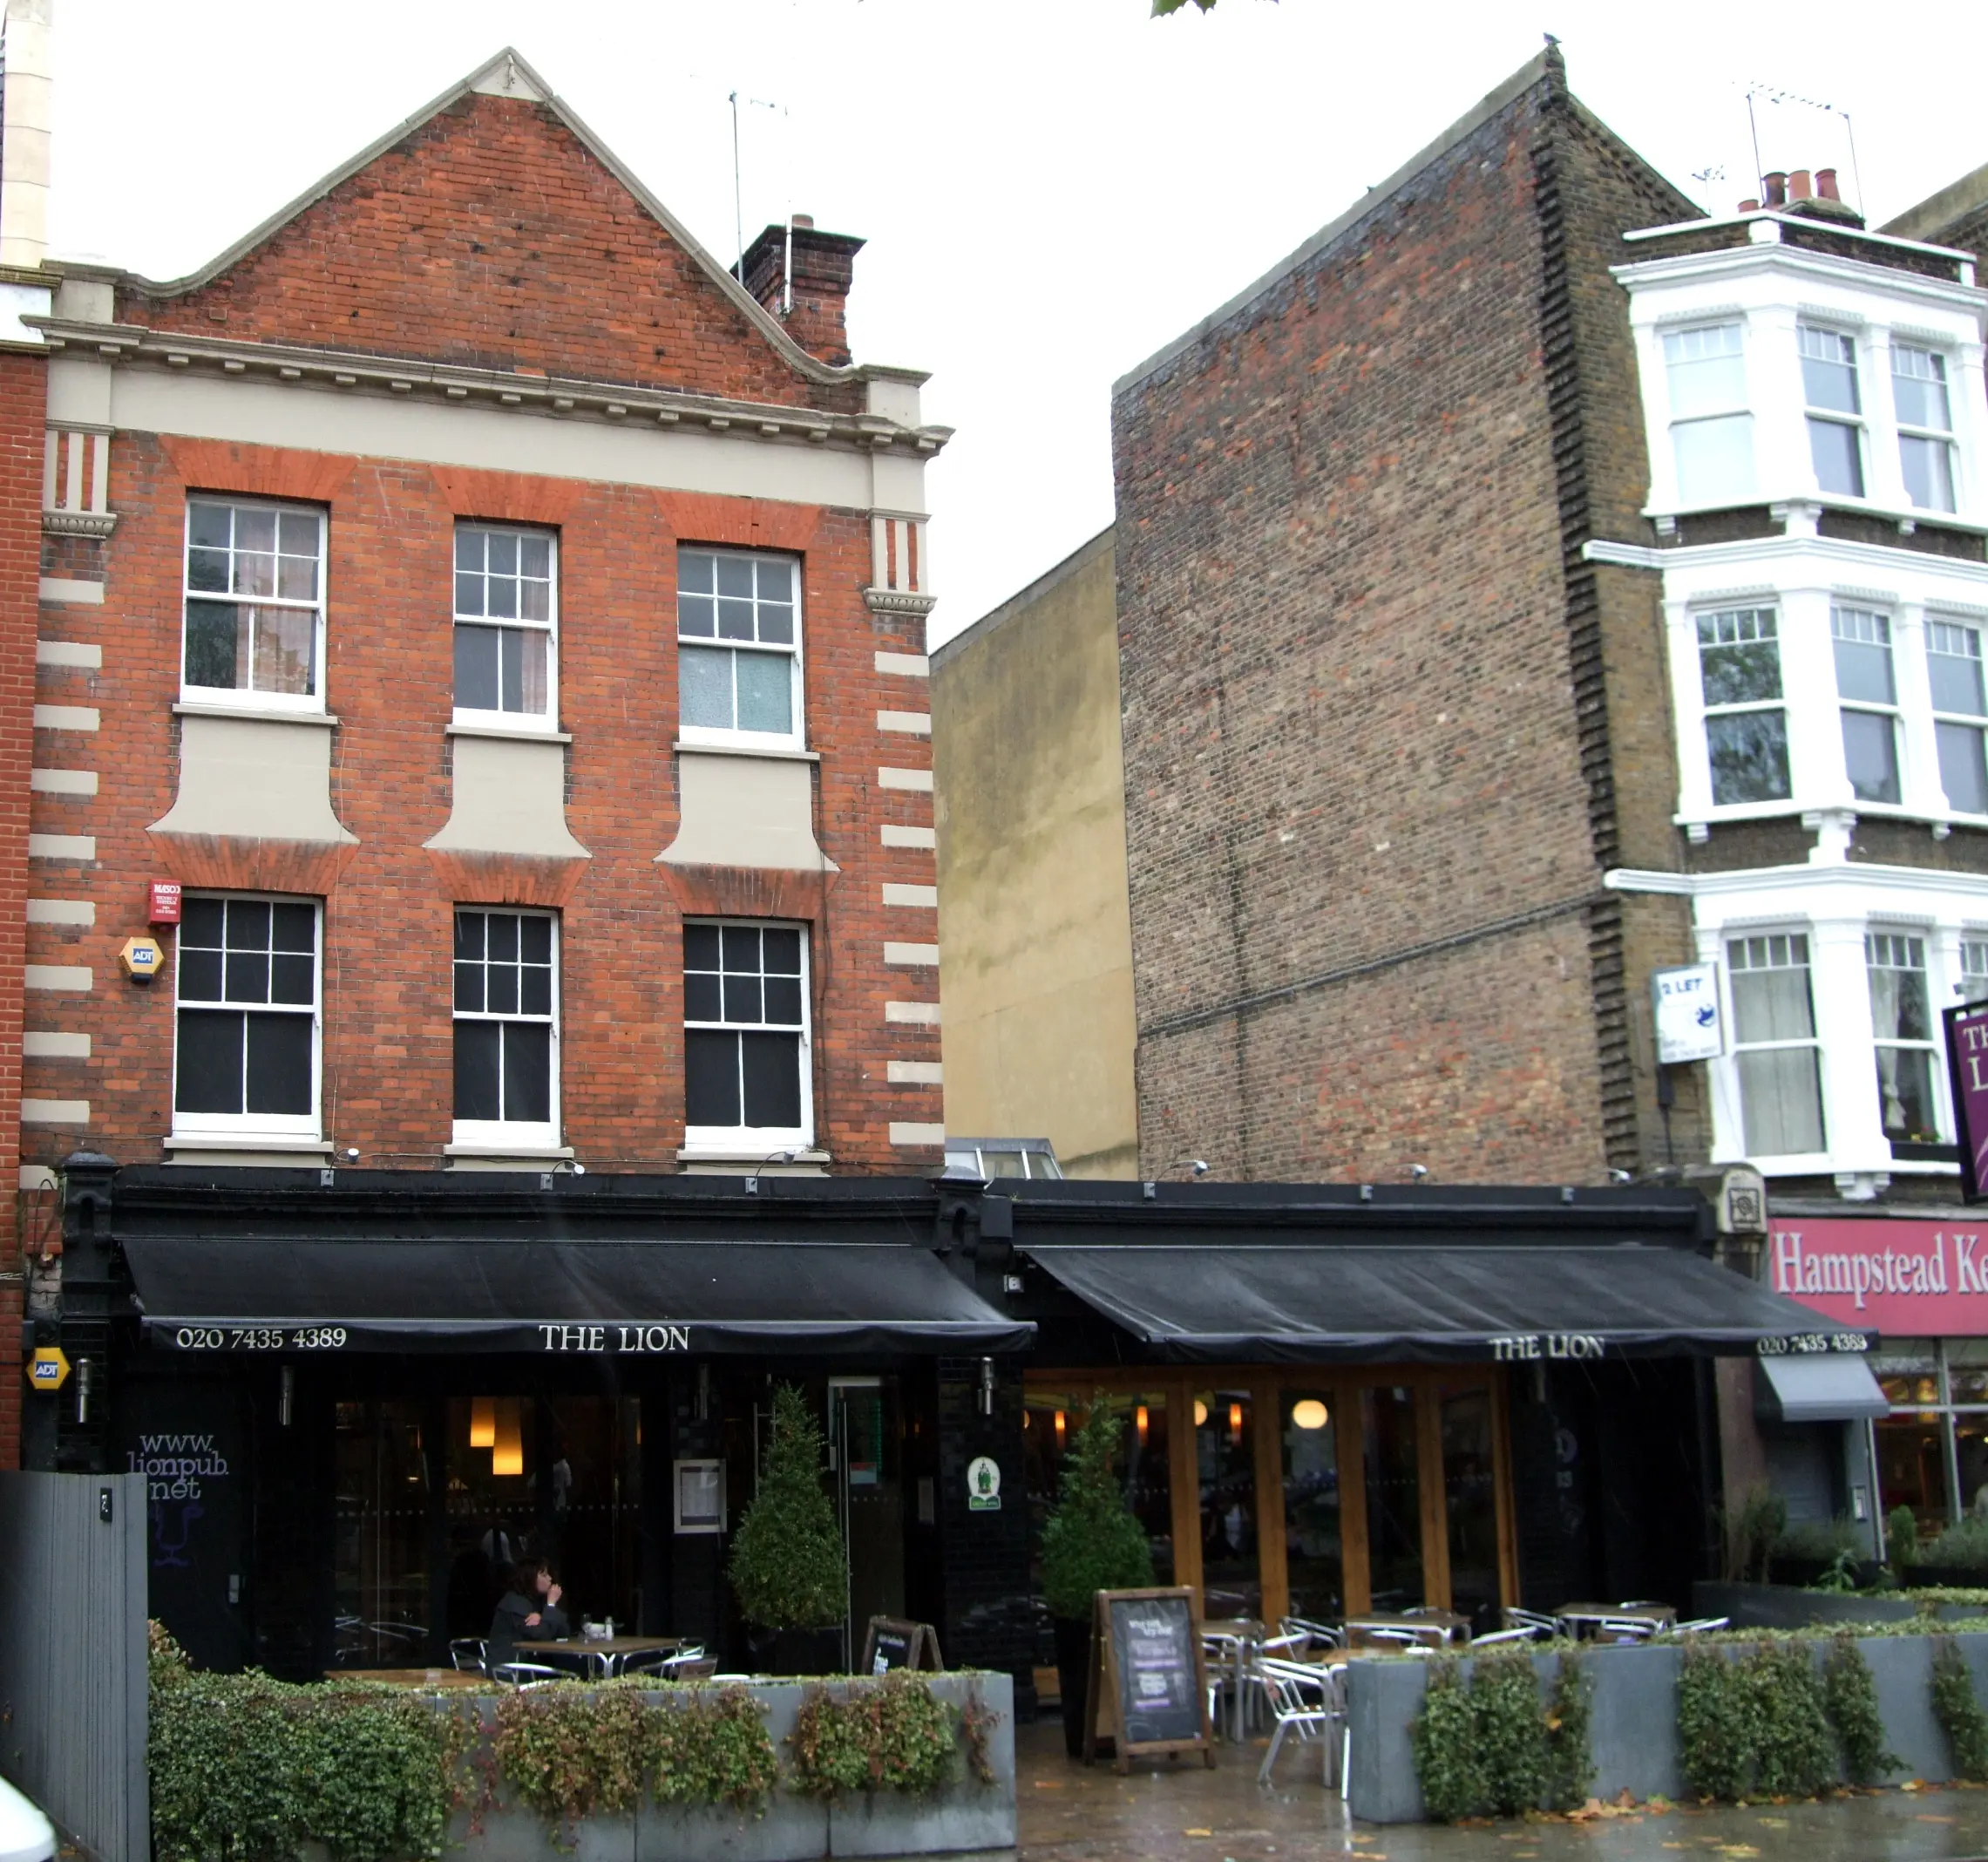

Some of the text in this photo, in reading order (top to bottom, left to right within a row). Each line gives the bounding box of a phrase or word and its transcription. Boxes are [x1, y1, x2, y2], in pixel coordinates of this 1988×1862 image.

[133, 951, 153, 962] ADT
[1676, 977, 1703, 993] LET
[1774, 1231, 1948, 1310] Hampstead
[176, 1328, 347, 1349] 020 7435 4389
[539, 1325, 690, 1351] THE LION
[1488, 1335, 1605, 1360] THE LION
[1790, 1333, 1828, 1353] 7435
[36, 1364, 58, 1376] ADT
[139, 1435, 214, 1452] www.
[126, 1451, 229, 1483] lionpub.
[149, 1477, 201, 1500] net
